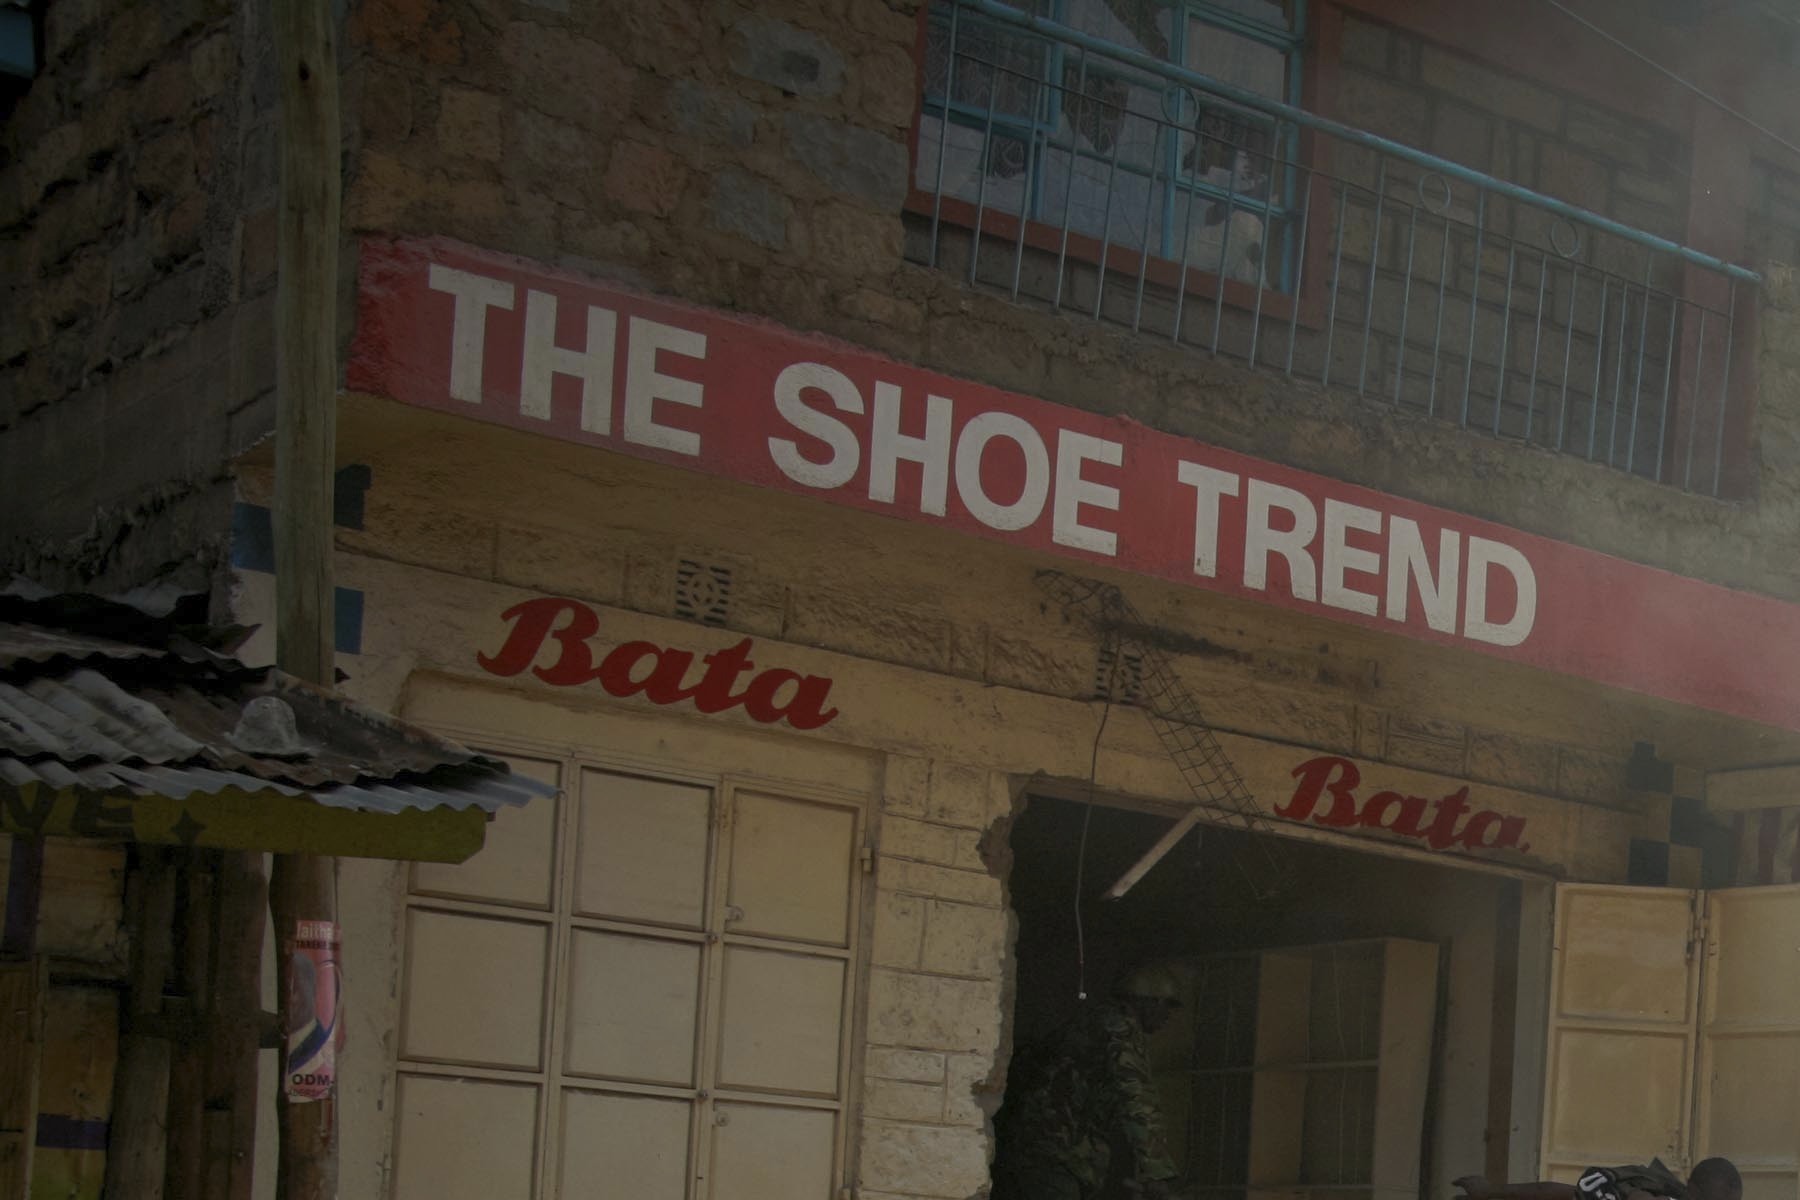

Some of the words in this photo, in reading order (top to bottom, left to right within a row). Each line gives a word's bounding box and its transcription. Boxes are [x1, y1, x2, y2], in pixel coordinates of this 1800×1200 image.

[428, 262, 707, 457] THE
[768, 361, 1124, 557] SHOE
[1177, 459, 1538, 648] TREND
[476, 596, 839, 731] Bata
[1273, 755, 1531, 854] Bata
